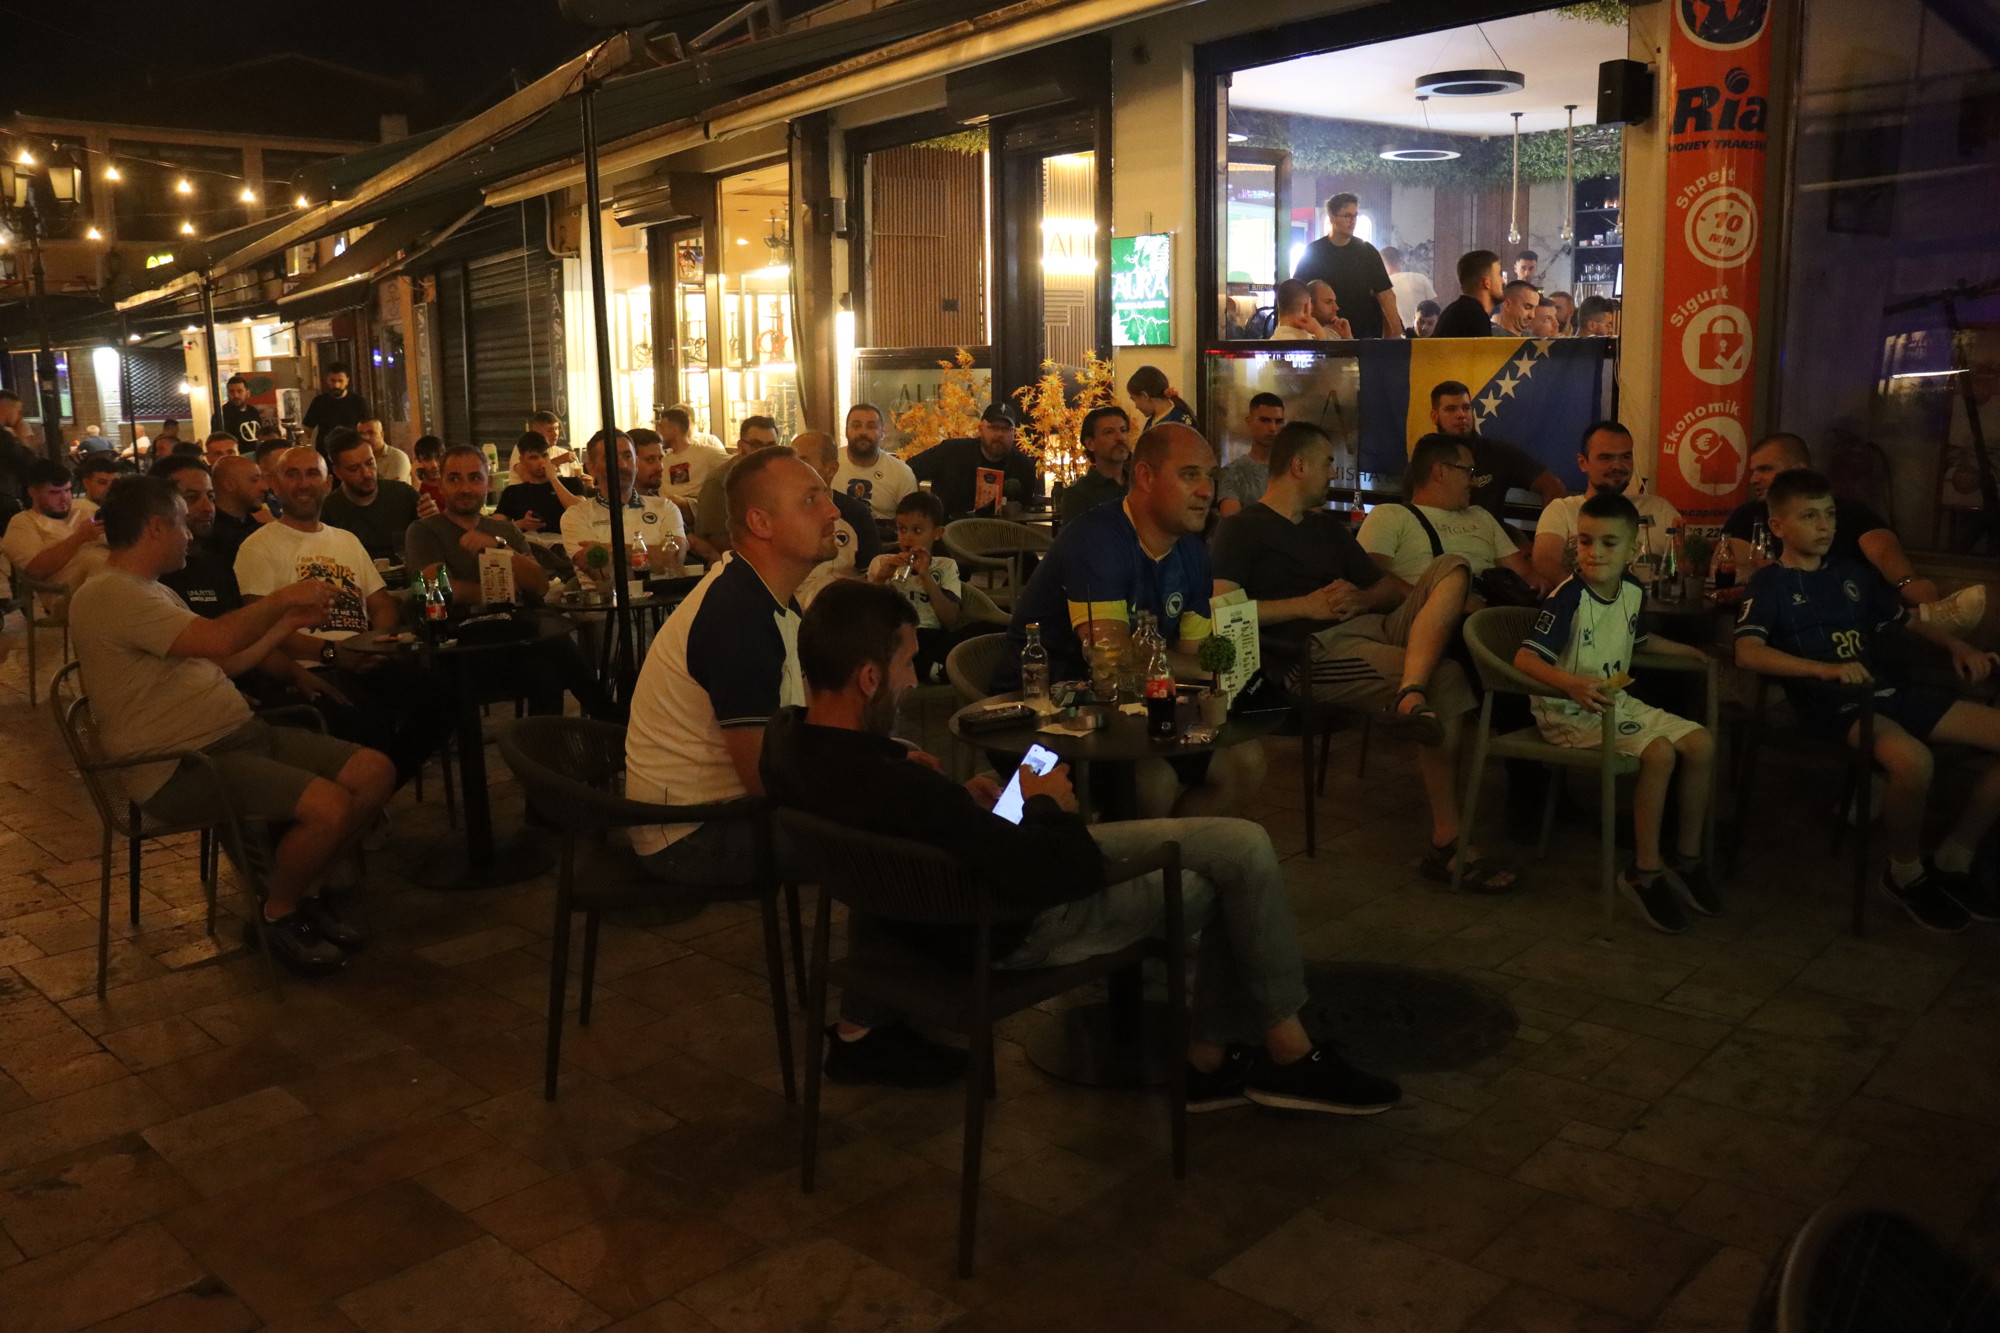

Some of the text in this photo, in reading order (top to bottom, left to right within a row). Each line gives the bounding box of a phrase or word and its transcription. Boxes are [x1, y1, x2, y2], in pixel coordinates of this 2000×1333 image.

[1673, 67, 1767, 135] Ria
[1675, 166, 1735, 209] Shpejt
[1708, 233, 1737, 247] MIN
[1714, 212, 1744, 233] 10
[1670, 284, 1729, 328] Sigurt
[1663, 399, 1740, 455] Ekonomik
[1831, 630, 1865, 659] 20
